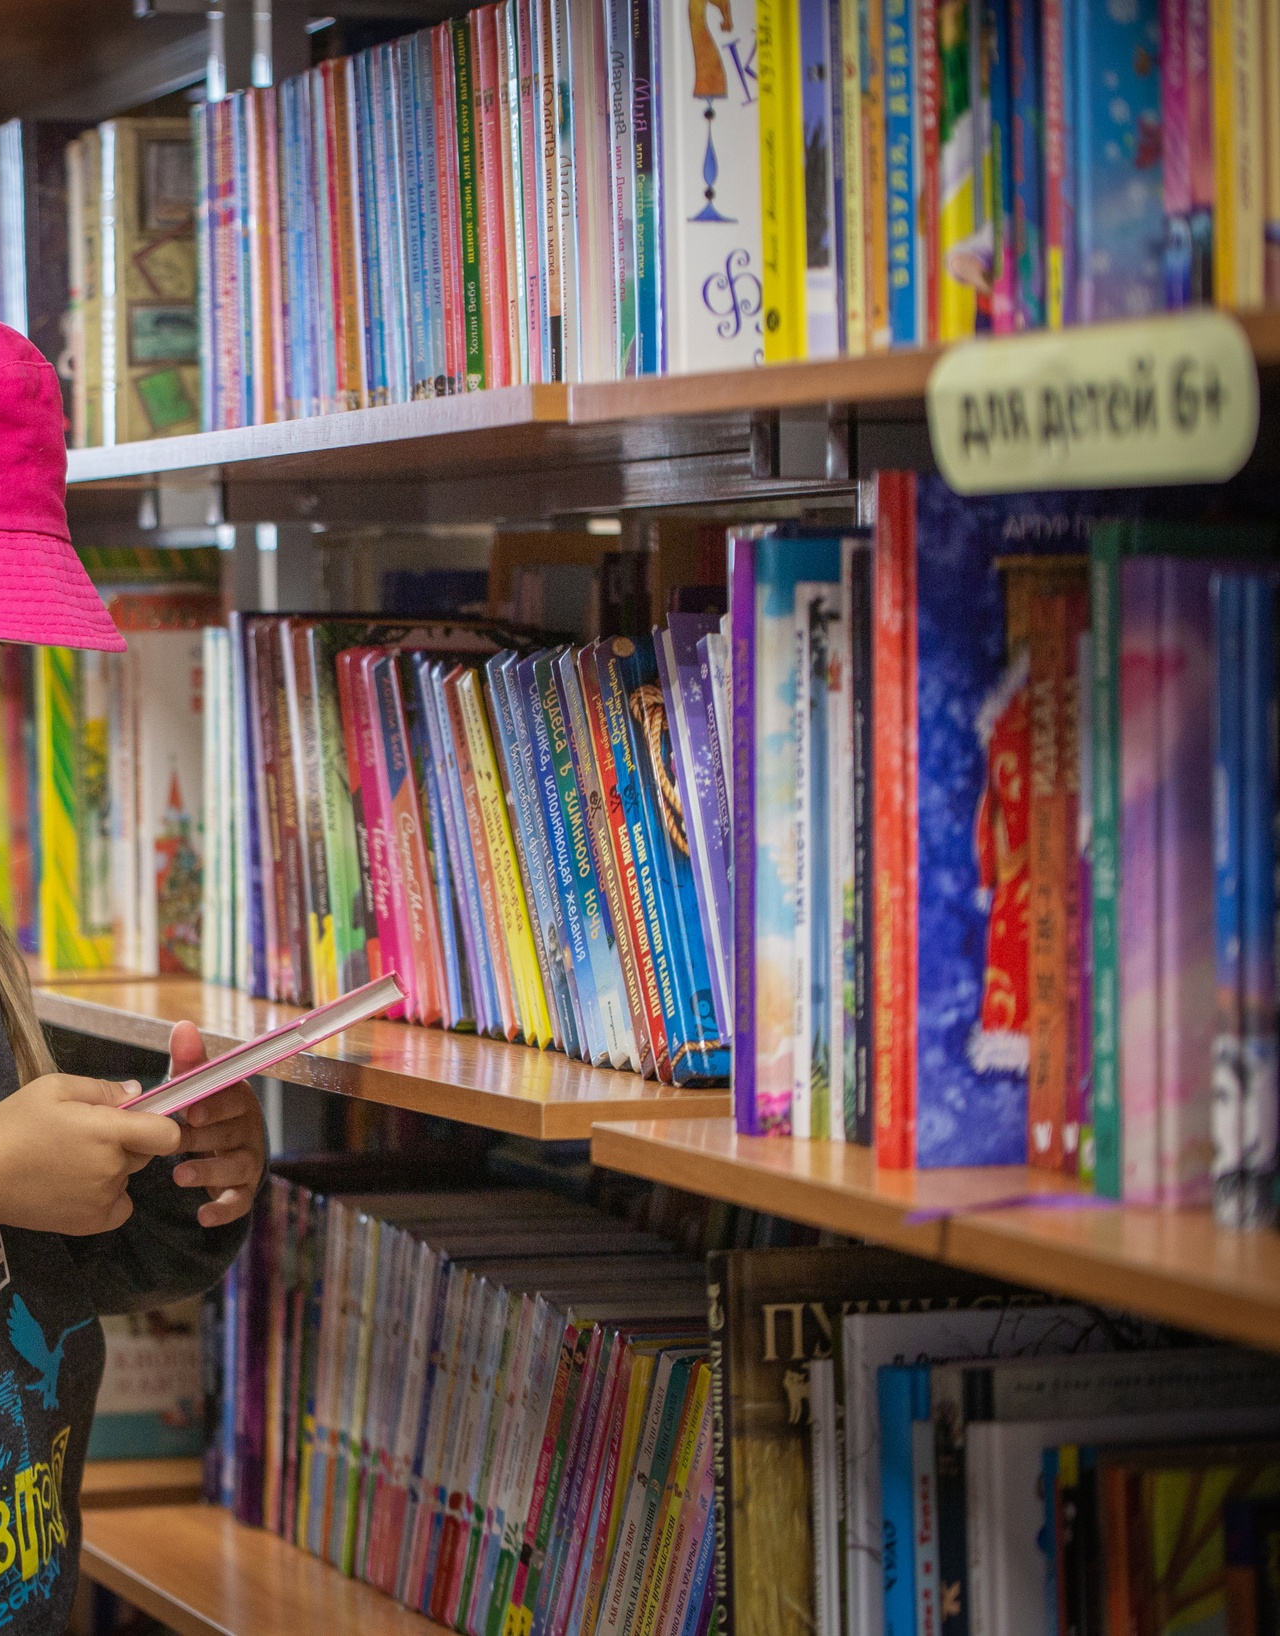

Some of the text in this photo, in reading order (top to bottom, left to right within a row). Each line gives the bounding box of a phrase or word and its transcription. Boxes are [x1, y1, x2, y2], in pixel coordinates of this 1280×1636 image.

[542, 0, 550, 35] ОЛЛИ
[425, 106, 435, 148] ЩЕНОК
[426, 153, 436, 187] ТОБИ,
[615, 146, 623, 170] или
[635, 143, 644, 168] или
[429, 190, 437, 214] ИЛИ
[458, 29, 480, 354] Холли Вебб ЩЕНОК ЭЛФИ, ИЛИ НЕ ХОЧУ БЫТЬ ОДИН!
[547, 198, 555, 219] Кот
[615, 177, 625, 231] Девочка
[636, 174, 646, 218] Сестра
[411, 234, 420, 283] ЩЕНОК
[431, 218, 441, 274] СТАРШИЙ
[548, 239, 556, 276] маске
[618, 238, 625, 252] из
[635, 223, 646, 278] русалки
[433, 278, 442, 307] ДРУГ
[618, 258, 627, 301] стекла
[413, 291, 423, 322] Вебб
[416, 325, 425, 362] Холли
[1039, 354, 1159, 454] детей
[1170, 356, 1230, 432] 6+
[506, 668, 519, 707] Холли
[513, 711, 527, 740] Вебб
[529, 781, 538, 799] по
[592, 692, 616, 771] На абордаж!
[605, 697, 622, 745] Остров
[494, 667, 550, 910] Холли Вебб Волшебная фигурка
[543, 677, 568, 754] Чудеса
[563, 787, 591, 878] зимнюю
[583, 888, 602, 940] ночь
[528, 682, 552, 772] Снежинка,
[542, 775, 573, 884] исполняющая
[565, 889, 587, 962] желания
[598, 827, 641, 1016] ПИРАТЫ КОШАЧЬЕГО МОРЯ
[618, 822, 661, 1018] ПИРАТЫ КОШАЧЬЕГО МОРЯ
[632, 821, 676, 1019] ПИРАТЫ КОШАЧЬЕГО МОРЯ
[530, 908, 551, 981] КАРМАНА
[612, 1403, 624, 1451] СЕКРЕТ
[661, 1393, 678, 1431] Смолл
[691, 1397, 703, 1428] Лили
[710, 1340, 724, 1479] ПУШИСТЫЕ
[657, 1435, 671, 1466] Лили
[681, 1431, 696, 1469] Смолл
[691, 1434, 709, 1470] Смолл
[601, 1487, 612, 1525] ПОНИ
[608, 1386, 665, 1626] КАК ПОЛЮБИТЬ ЗИМУ Лили Смолл
[639, 1501, 658, 1558] РОЖДЕНИЯ
[651, 1514, 677, 1602] НЕПОСЛУШНЫЙ
[675, 1524, 685, 1551] ОЧЕНЬ
[696, 1514, 715, 1585] СЮРПРИЗОМ
[714, 1486, 727, 1597] ИСТОРИИ
[631, 1586, 640, 1598] НА
[634, 1561, 645, 1585] ДЕНЬ
[661, 1552, 680, 1612] ЗАБЫВЧИВЫЙ
[676, 1538, 699, 1617] БЫТЬ ХРАБРЫМ
